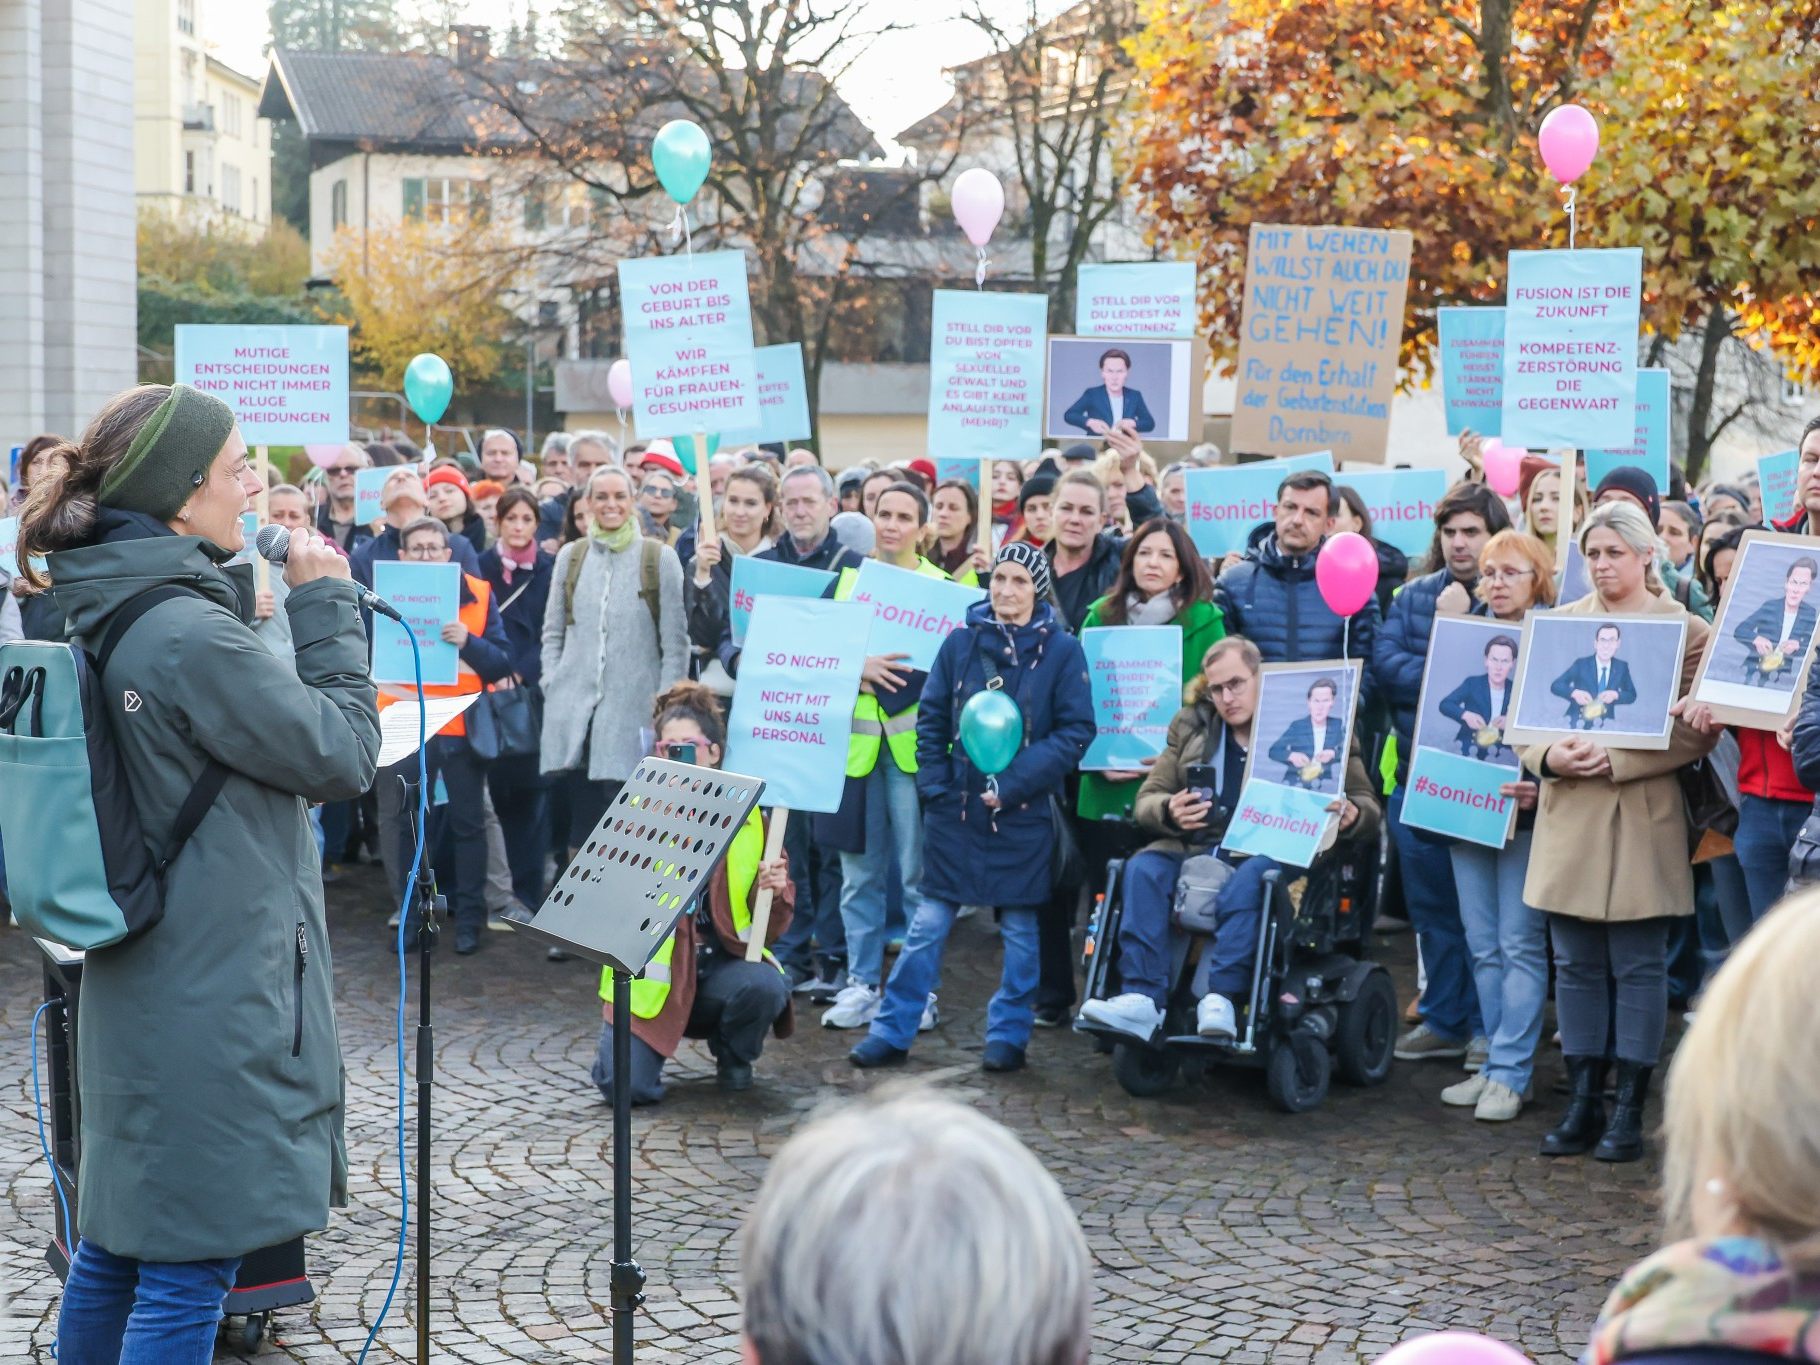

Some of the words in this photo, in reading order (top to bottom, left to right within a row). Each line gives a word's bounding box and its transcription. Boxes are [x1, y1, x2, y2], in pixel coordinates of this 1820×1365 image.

[1256, 231, 1292, 249] MIT
[1307, 232, 1389, 254] WEHEN
[1254, 256, 1324, 280] WILLST
[1332, 259, 1378, 283] AUCH
[1383, 260, 1407, 282] DU
[649, 283, 682, 295] VON
[688, 279, 718, 291] DER
[1516, 288, 1573, 299] FUSION
[1578, 288, 1599, 299] IST
[1605, 287, 1631, 298] DIE
[641, 298, 702, 313] GEBURT
[707, 295, 731, 307] BIS
[1092, 296, 1126, 305] STELL
[1130, 296, 1151, 305] DIR
[1155, 295, 1180, 304] VOR
[1254, 285, 1314, 312] NICHT
[1329, 289, 1388, 315] WEIT
[1091, 311, 1108, 319] DU
[1112, 310, 1160, 319] LEIDEST
[1164, 309, 1181, 318] AN
[1536, 305, 1609, 318] ZUKUNFT
[650, 318, 674, 330] INS
[679, 313, 726, 327] ALTER
[947, 322, 980, 333] STELL
[984, 324, 1003, 333] DIR
[1007, 325, 1032, 334] VOR
[1250, 313, 1388, 349] GEHEN!
[945, 336, 961, 345] DU
[965, 337, 990, 346] BIST
[994, 339, 1032, 347] OPFER
[1520, 342, 1621, 354] KOMPETENZ-
[235, 348, 289, 358] MUTIGE
[676, 349, 706, 361] WIR
[976, 352, 1001, 360] VON
[195, 364, 330, 374] ENTSCHEIDUNGEN
[656, 364, 730, 380] KÄMPFEN
[955, 363, 1021, 374] SEXUELLER
[1280, 360, 1312, 384] den
[1517, 359, 1622, 373] ZERSTÖRUNG
[194, 380, 228, 390] SIND
[234, 380, 277, 390] NICHT
[282, 380, 330, 390] IMMER
[948, 377, 996, 387] GEWALT
[1000, 379, 1027, 388] UND
[1556, 380, 1581, 391] DIE
[644, 384, 674, 399] FÜR
[679, 380, 745, 396] FRAUEN-
[946, 390, 959, 399] ES
[963, 391, 989, 400] GIBT
[993, 392, 1027, 401] KEINE
[239, 396, 286, 407] KLUGE
[648, 396, 744, 415] GESUNDHEIT
[1518, 398, 1619, 410] GEGENWART
[942, 404, 1030, 415] ANLAUFSTELLE
[236, 412, 330, 422] CHEIDUNGEN
[1192, 499, 1276, 521] #sonich
[766, 653, 785, 665] SO
[791, 655, 840, 670] NICHT!
[761, 691, 802, 705] NICHT
[805, 694, 830, 707] MIT
[764, 711, 791, 723] UNS
[795, 713, 820, 724] ALS
[752, 727, 826, 745] PERSONAL
[1415, 775, 1506, 814] #sonicht
[1240, 806, 1320, 837] #sonicht
